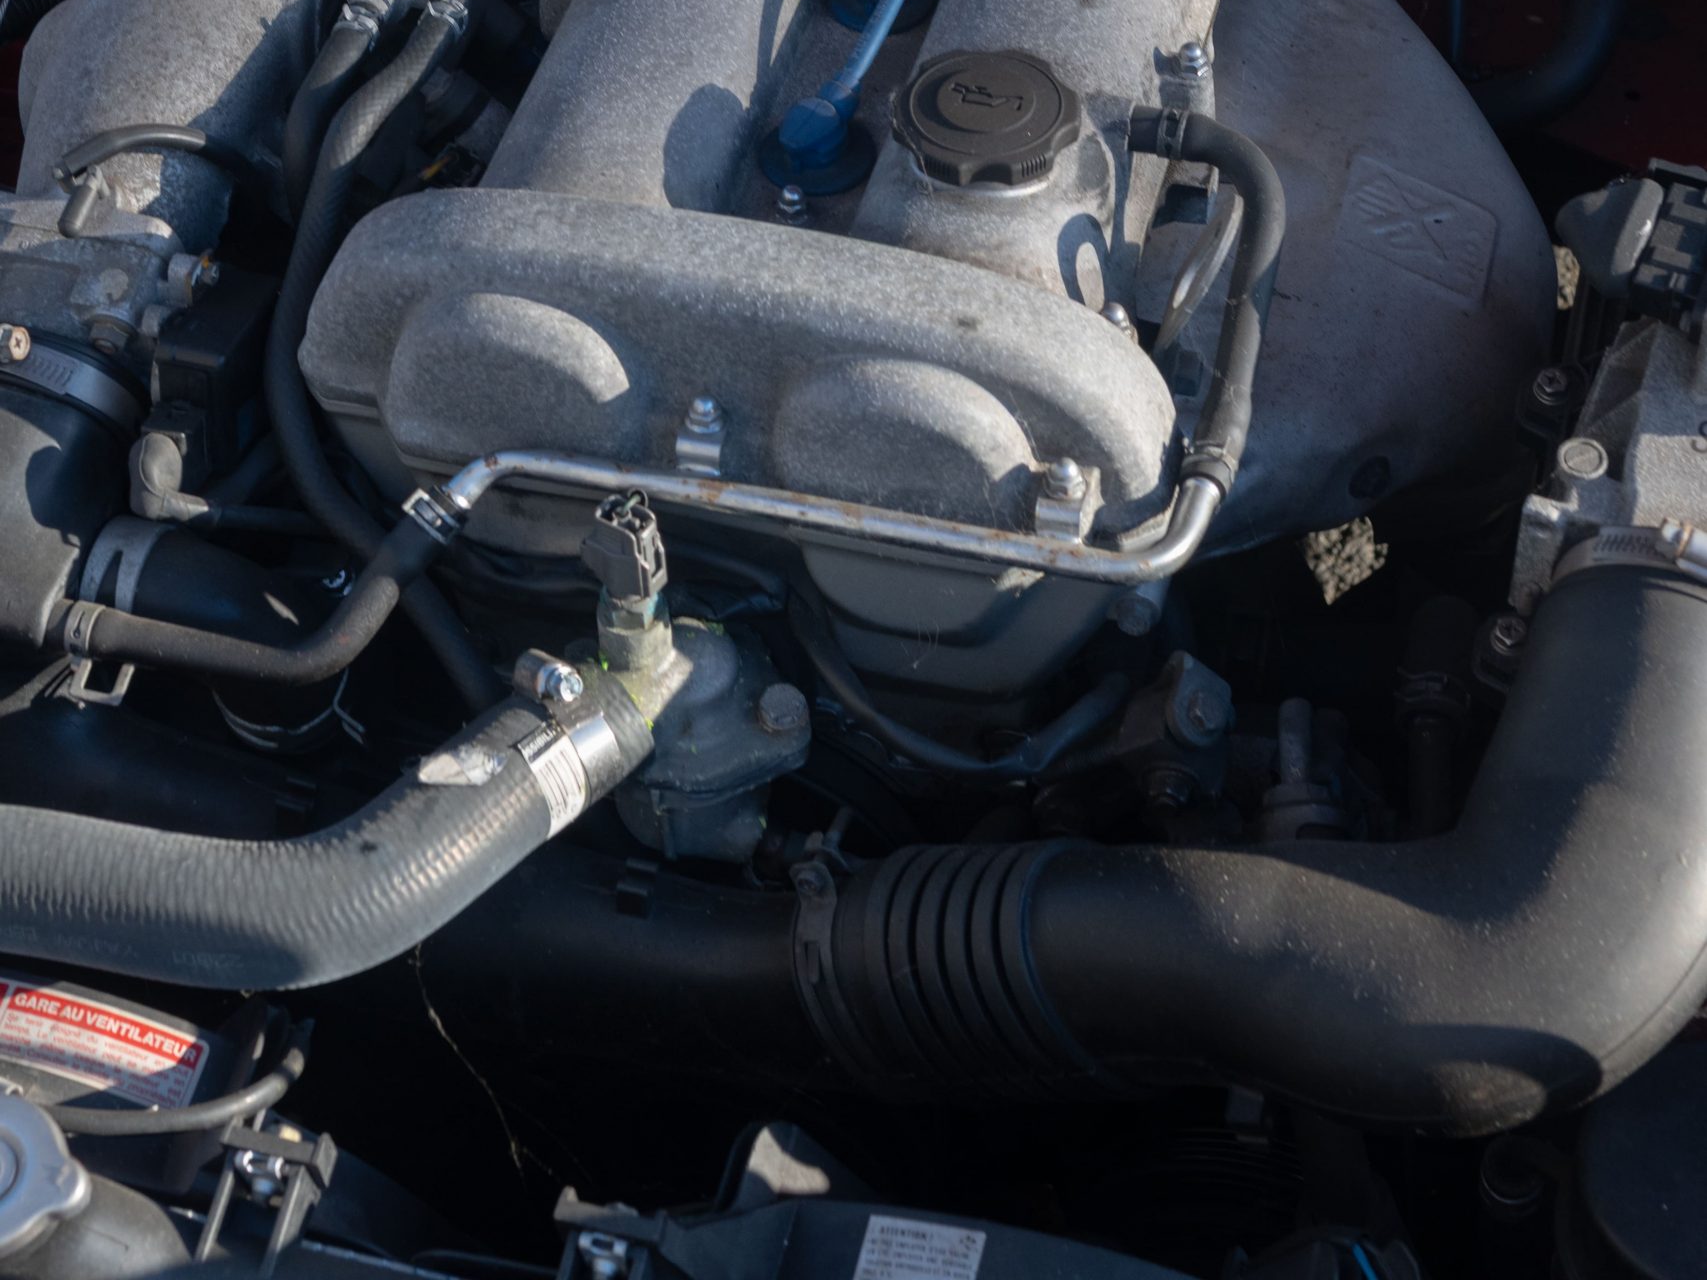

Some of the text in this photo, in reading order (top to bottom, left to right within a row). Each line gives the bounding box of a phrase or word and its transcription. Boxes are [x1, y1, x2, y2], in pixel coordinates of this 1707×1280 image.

[14, 993, 59, 1016] GARE
[61, 1005, 84, 1022] AU
[86, 1008, 197, 1062] VENTILATEUR
